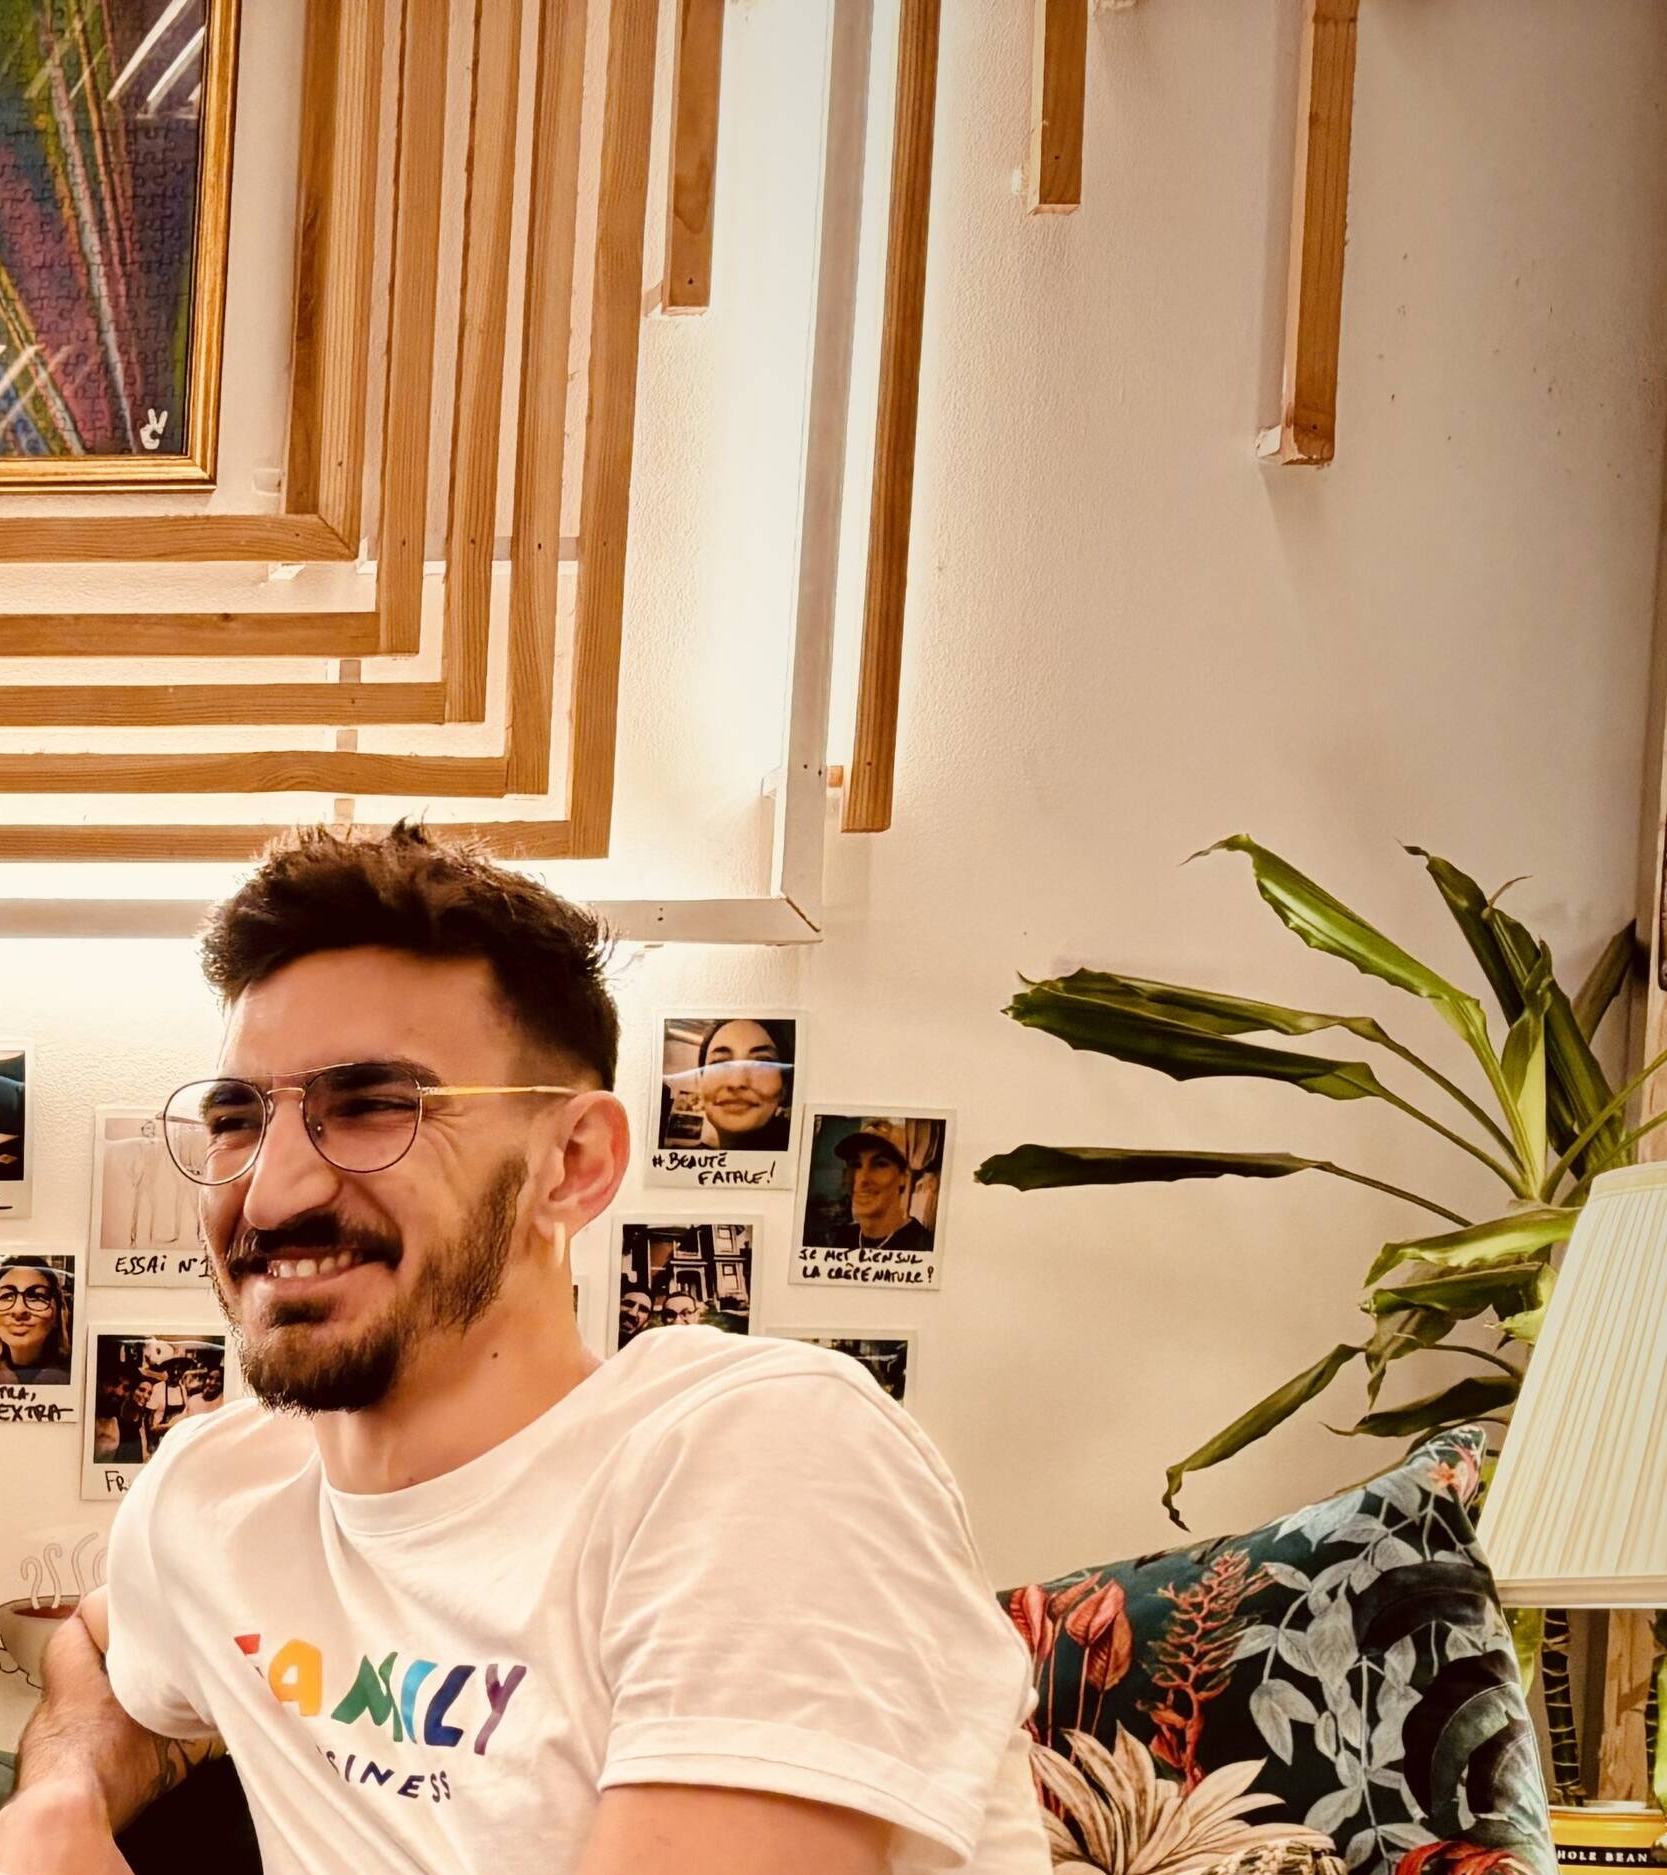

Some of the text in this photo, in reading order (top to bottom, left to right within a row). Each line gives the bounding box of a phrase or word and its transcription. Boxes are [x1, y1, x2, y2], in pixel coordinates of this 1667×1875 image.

[234, 1633, 527, 1756] AMILY
[314, 1744, 452, 1803] SINESS
[1556, 1849, 1648, 1863] HOLE BEAN
